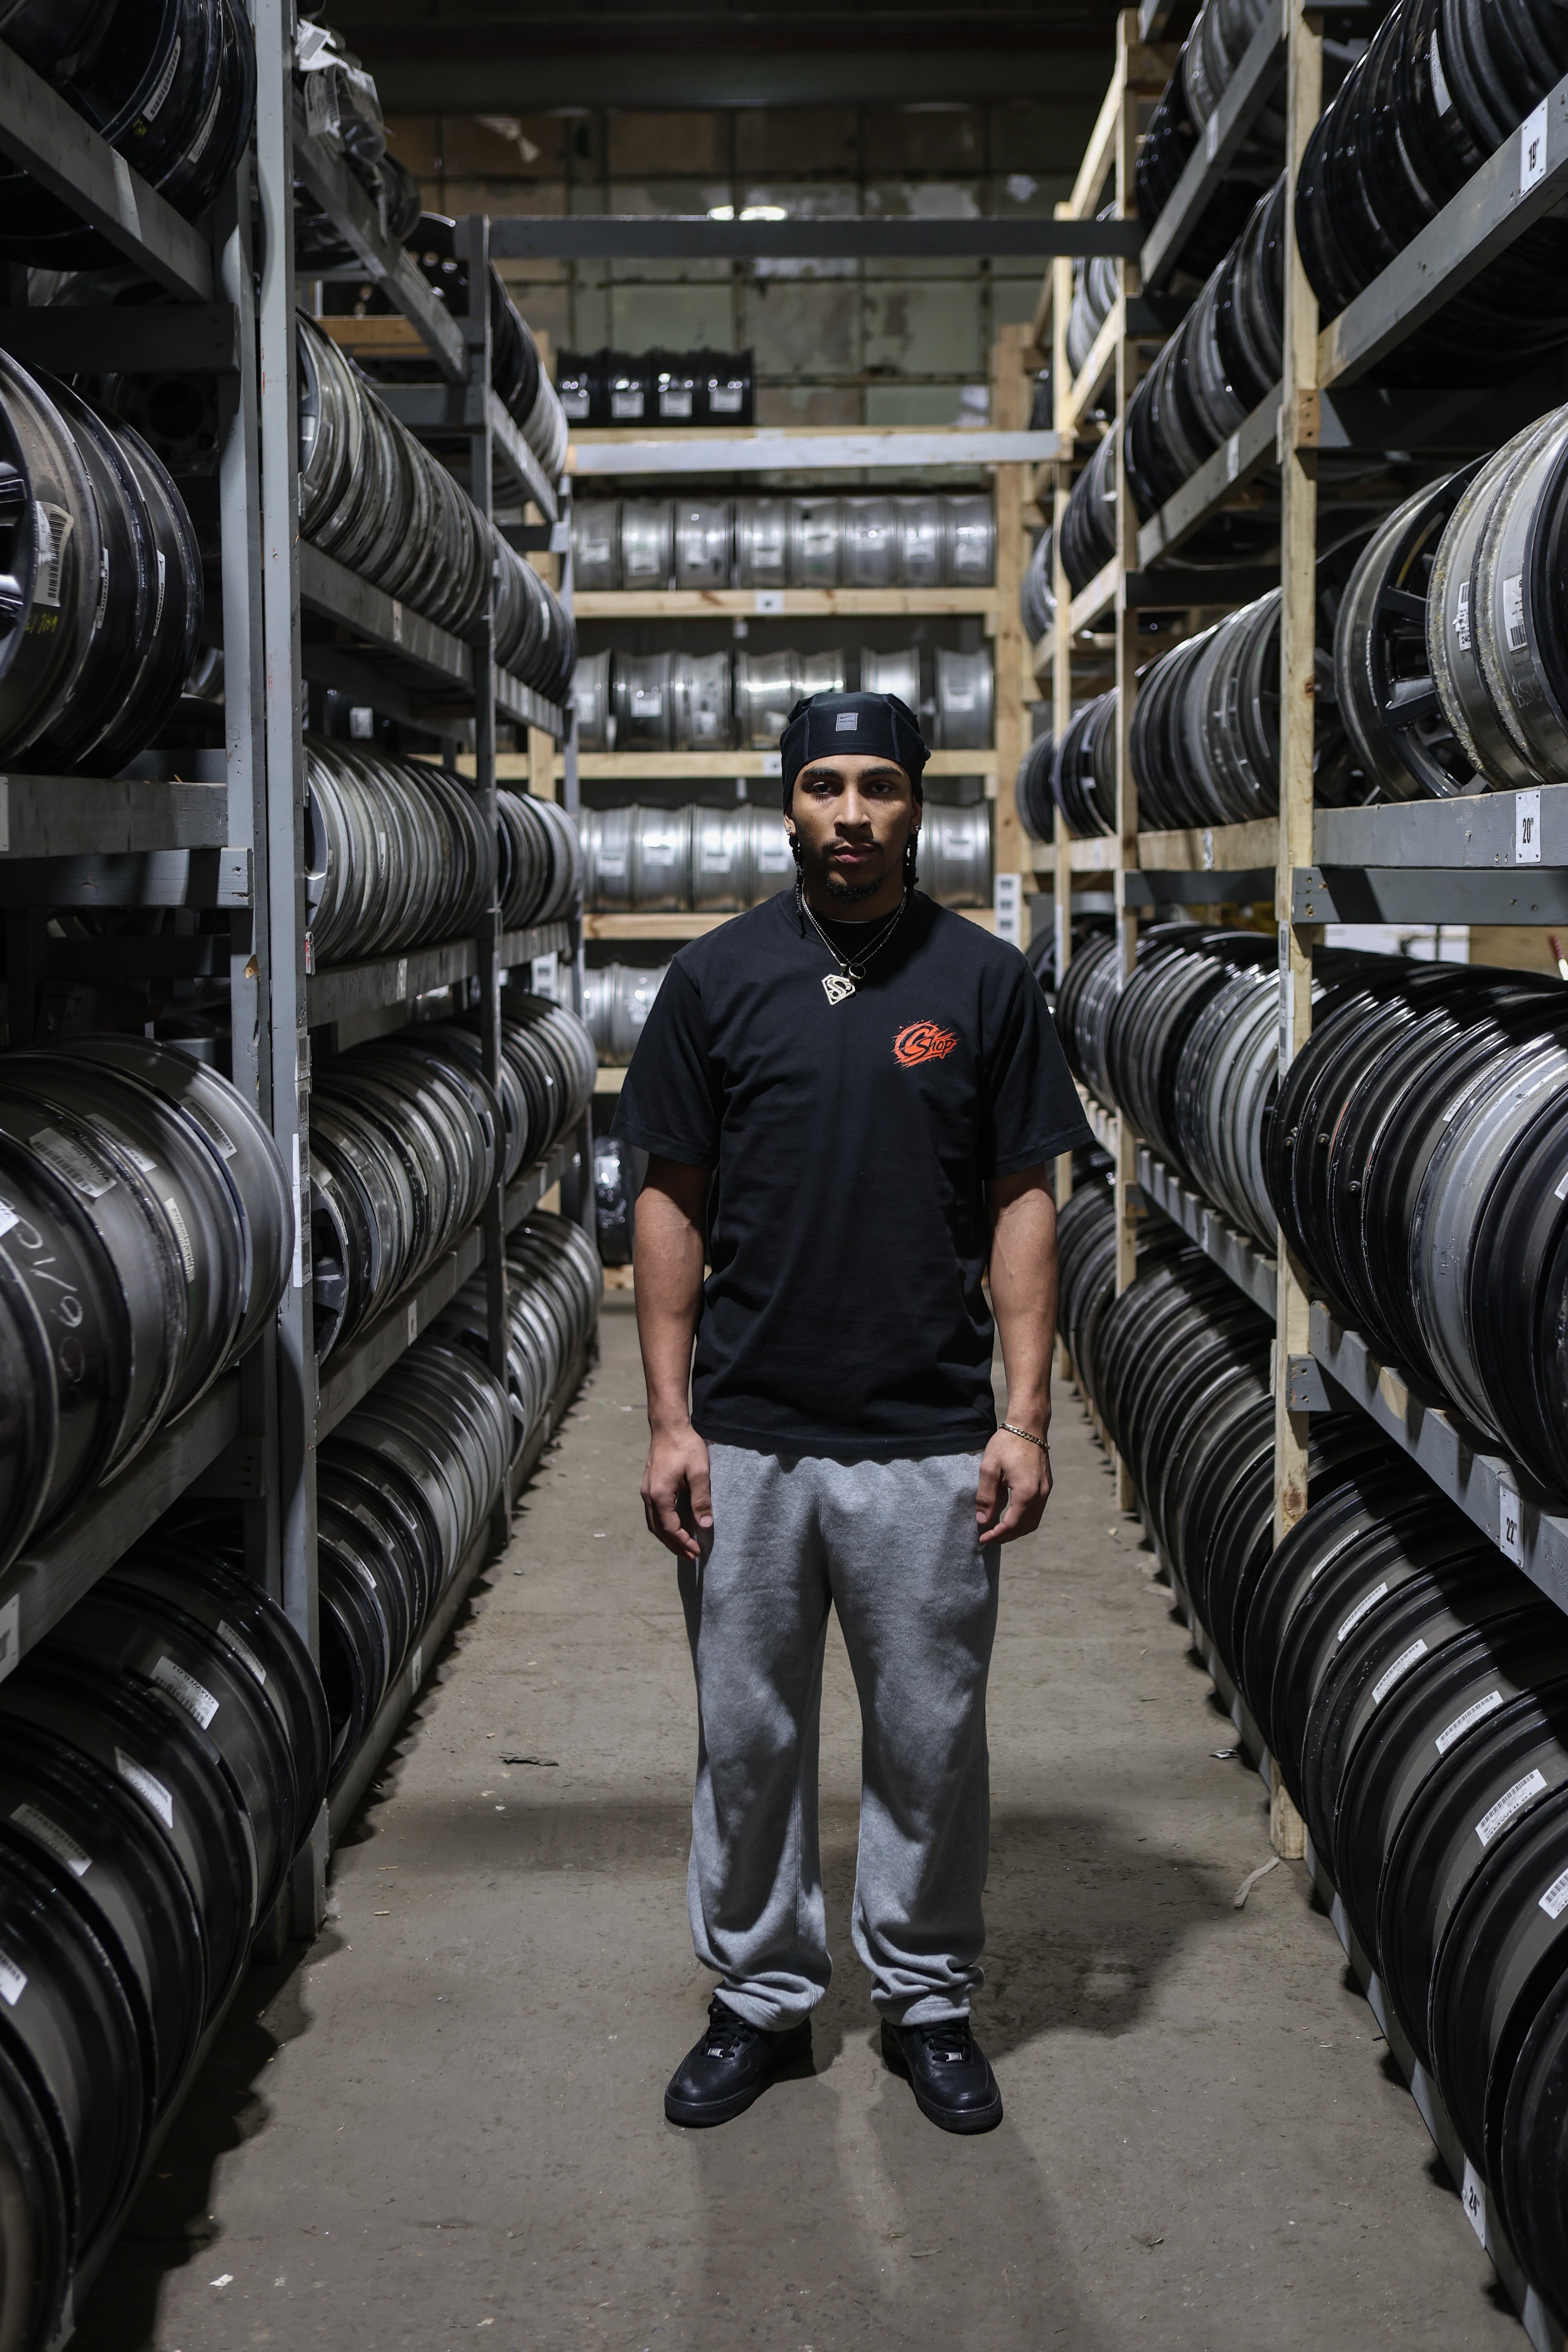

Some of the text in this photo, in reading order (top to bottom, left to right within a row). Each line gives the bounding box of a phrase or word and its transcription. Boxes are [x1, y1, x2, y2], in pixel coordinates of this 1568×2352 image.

[1528, 136, 1539, 172] 19"
[1523, 817, 1533, 844] 20"
[1506, 1517, 1517, 1546] 22"
[1470, 2186, 1480, 2217] 24"
